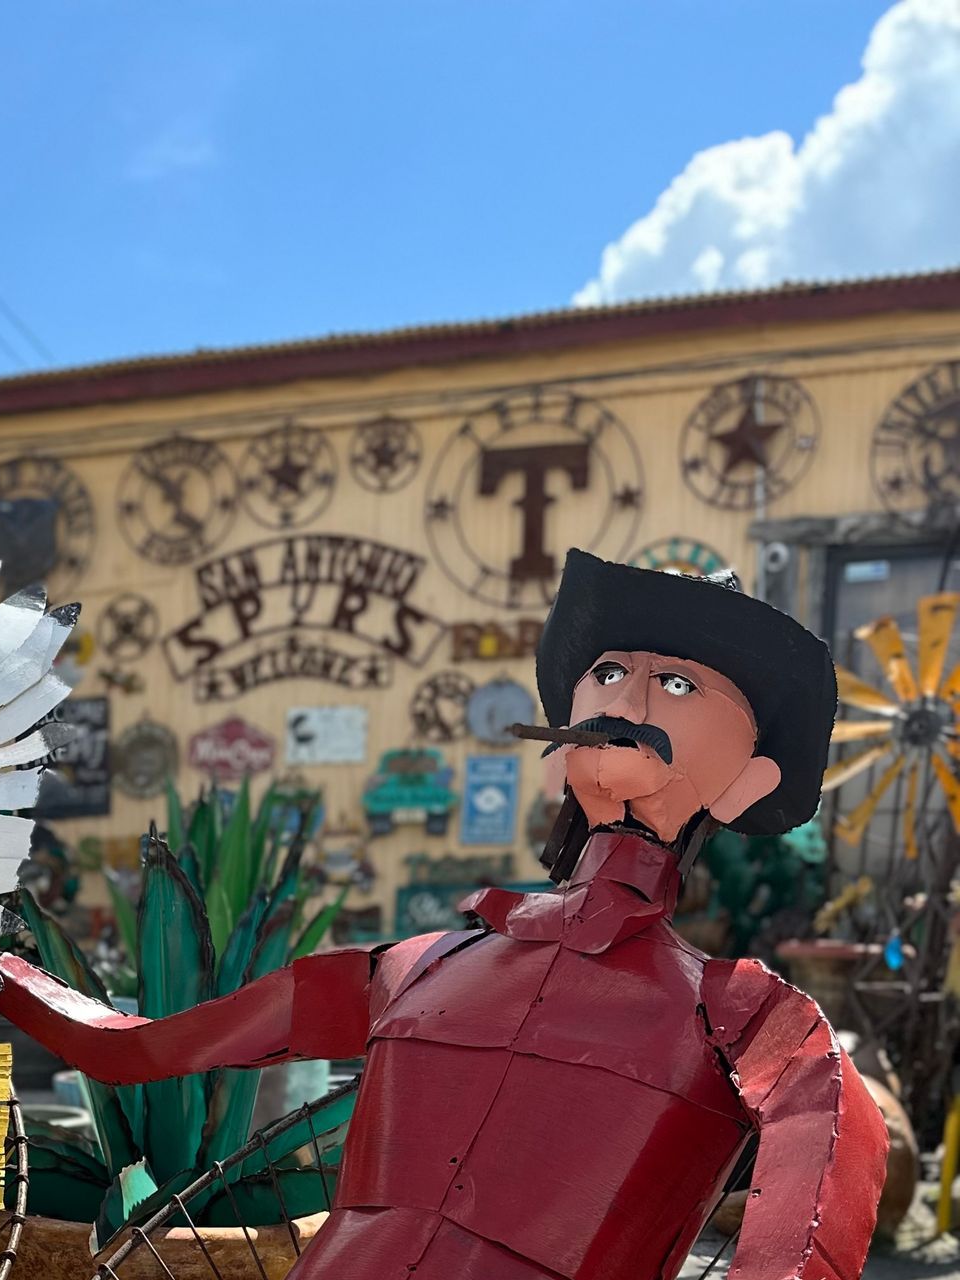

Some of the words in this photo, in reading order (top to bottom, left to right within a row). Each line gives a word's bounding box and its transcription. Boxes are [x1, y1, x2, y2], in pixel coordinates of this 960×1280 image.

[197, 548, 261, 609] SAN
[282, 537, 424, 600] ANTONIO
[177, 578, 426, 665] SPURS
